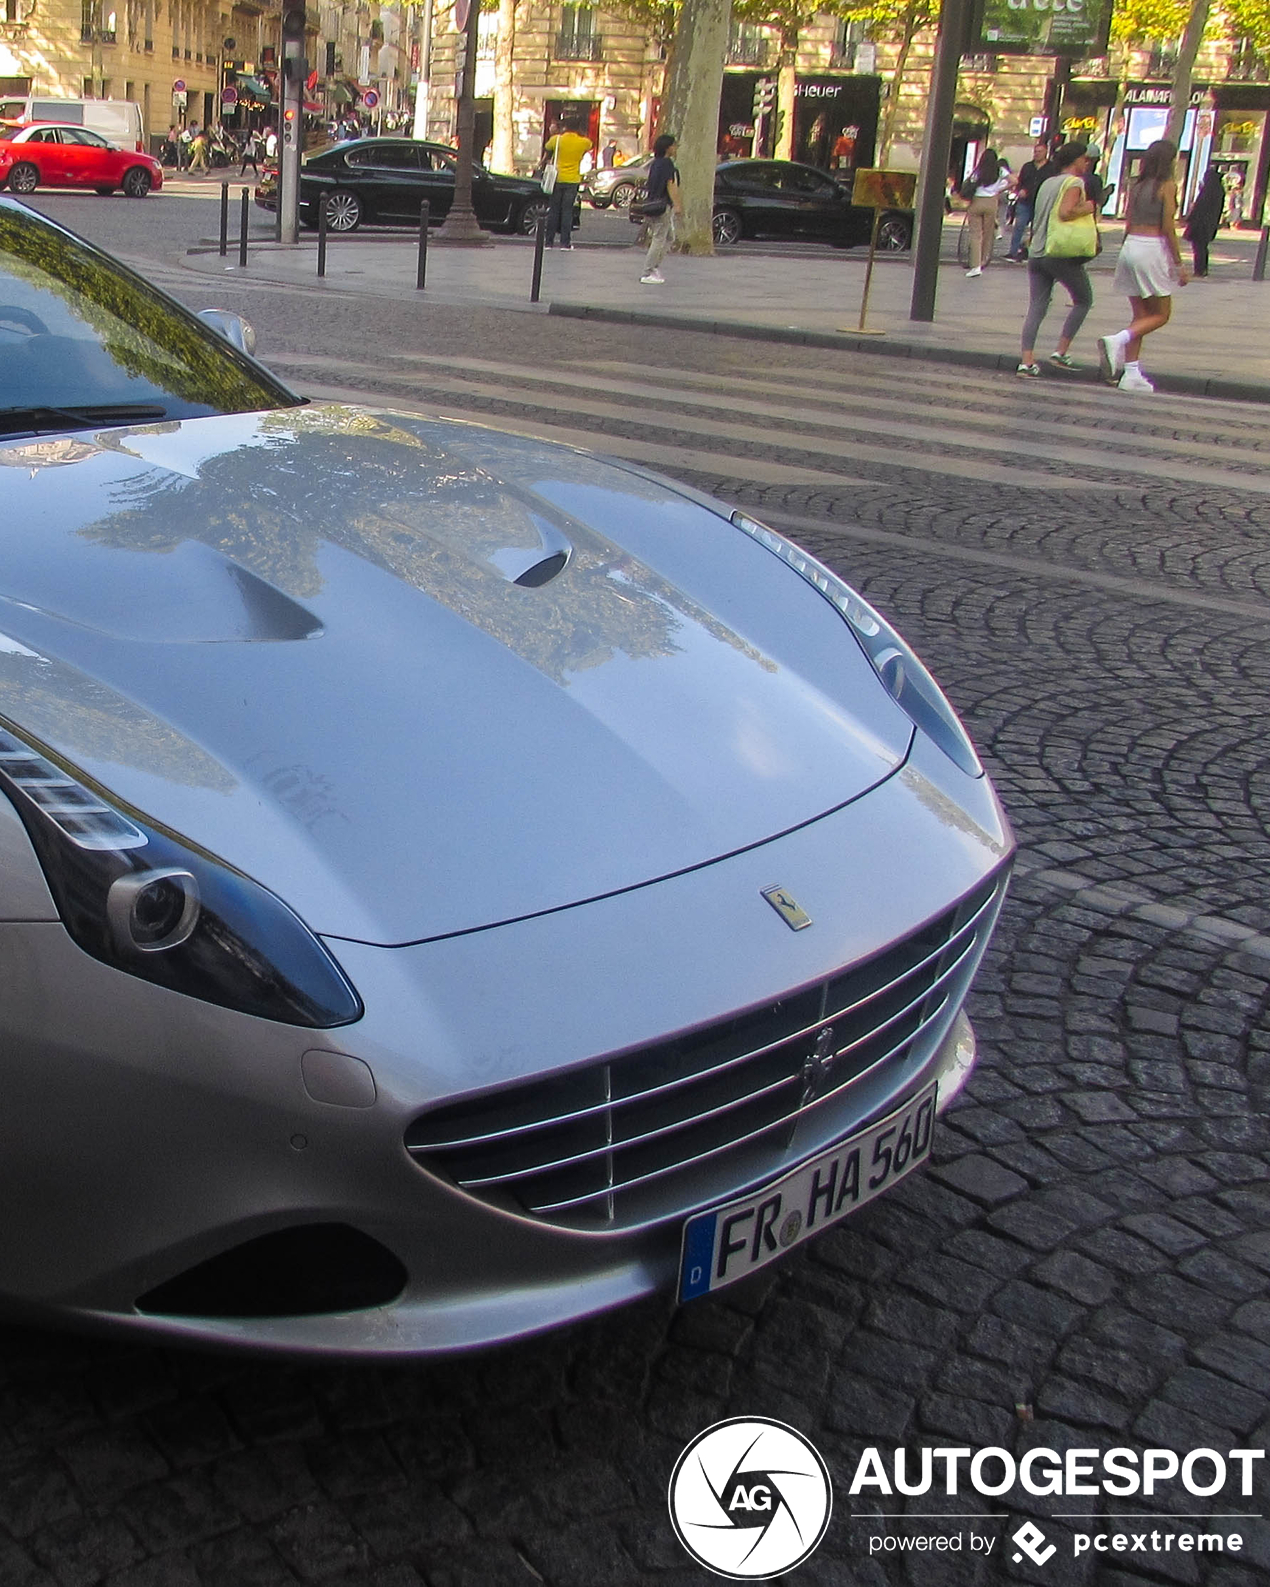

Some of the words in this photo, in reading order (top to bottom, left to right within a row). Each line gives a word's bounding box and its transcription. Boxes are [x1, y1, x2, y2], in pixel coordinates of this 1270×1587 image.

[716, 1191, 782, 1278] FR
[806, 1147, 861, 1228] HA
[868, 1095, 935, 1190] 560
